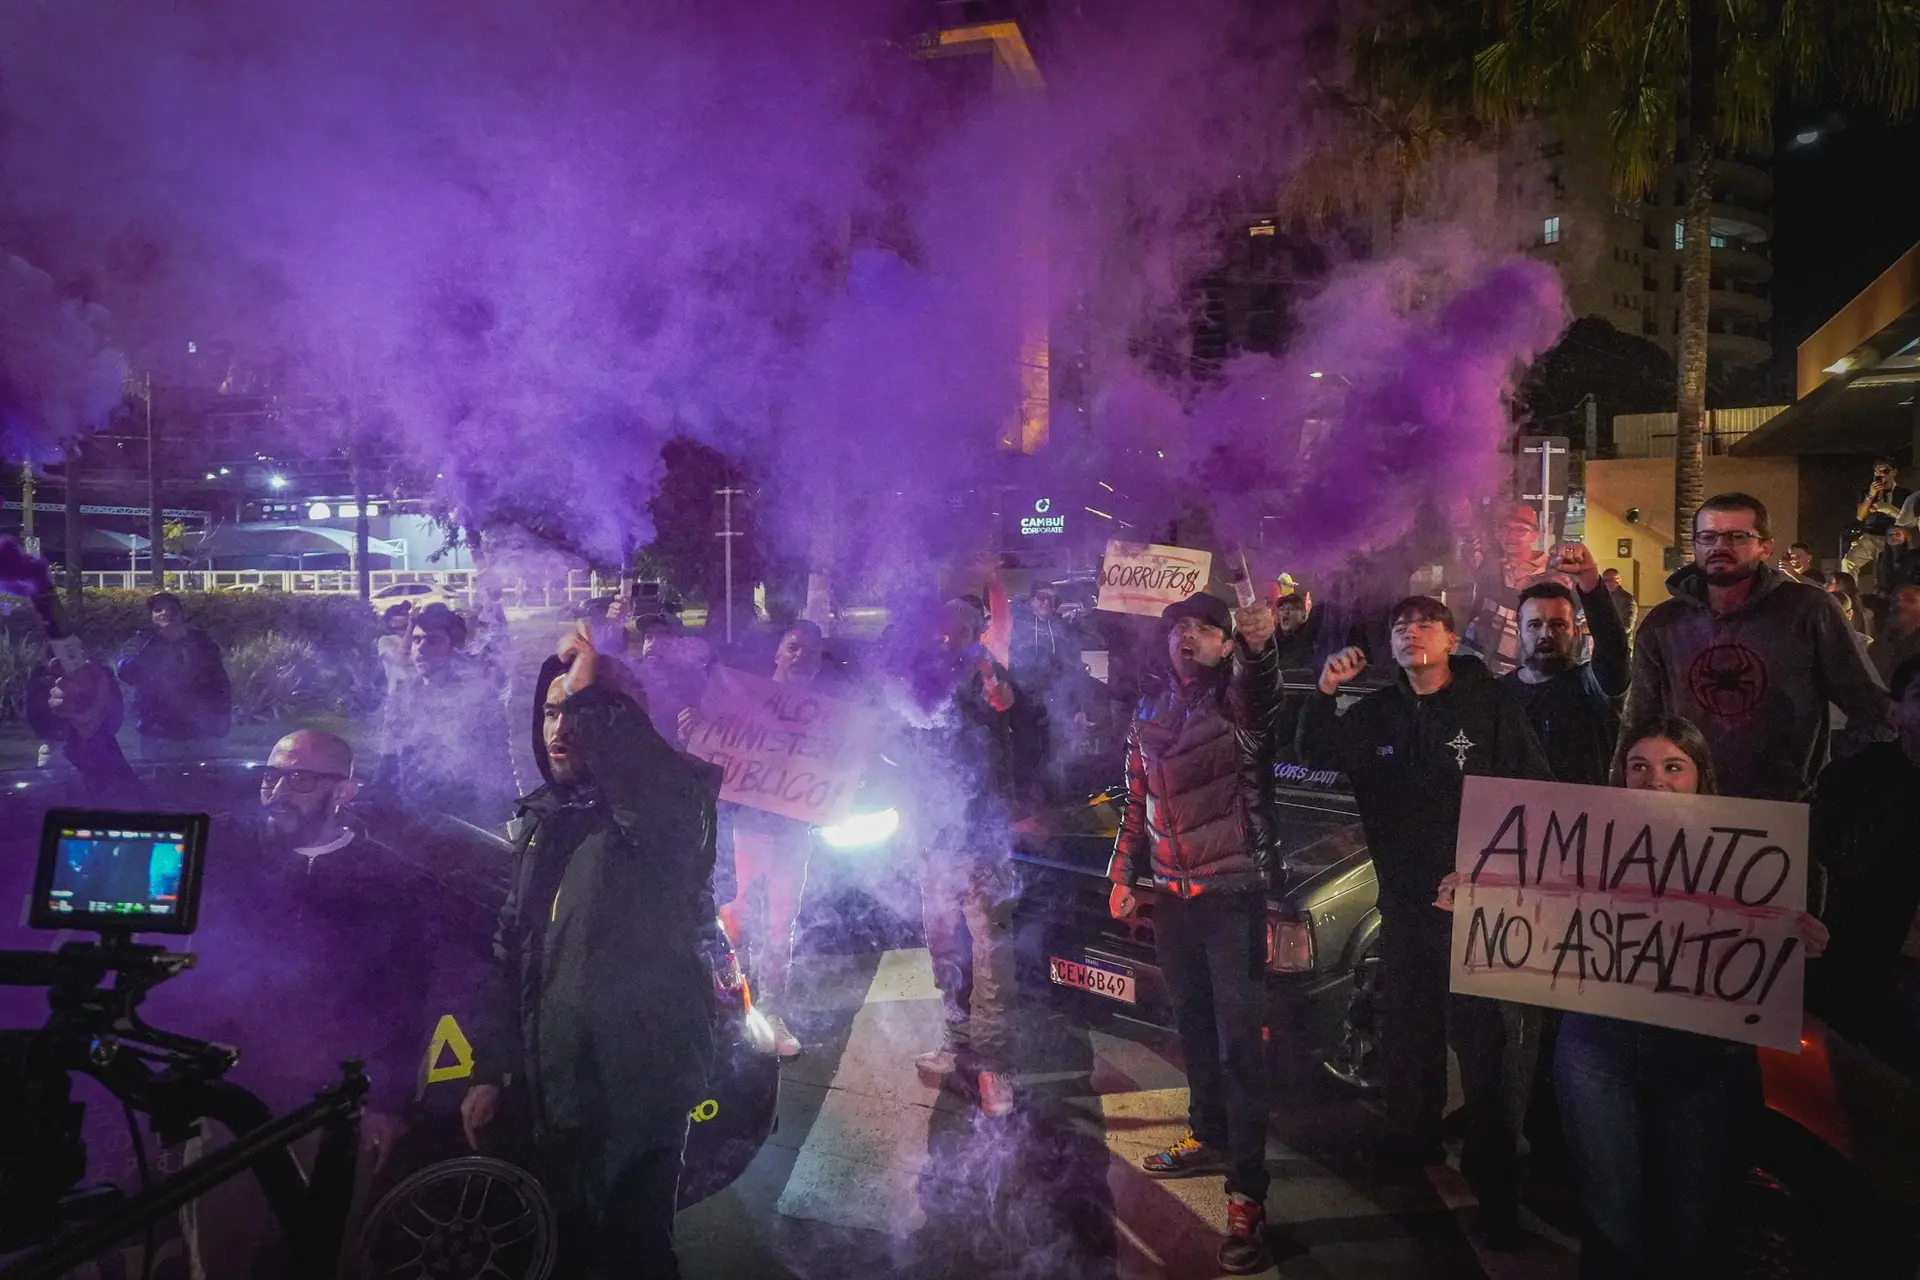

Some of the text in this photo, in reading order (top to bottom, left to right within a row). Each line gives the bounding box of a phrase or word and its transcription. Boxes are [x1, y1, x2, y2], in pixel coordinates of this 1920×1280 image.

[1021, 515, 1065, 527] CAMBUÍ
[1021, 527, 1064, 535] CORPORATE
[1107, 564, 1201, 597] CORRUPTO$
[1470, 804, 1791, 907] AMIANTO
[1057, 961, 1126, 997] CEW6B49
[1464, 906, 1799, 1025] NO ASFALTO!
